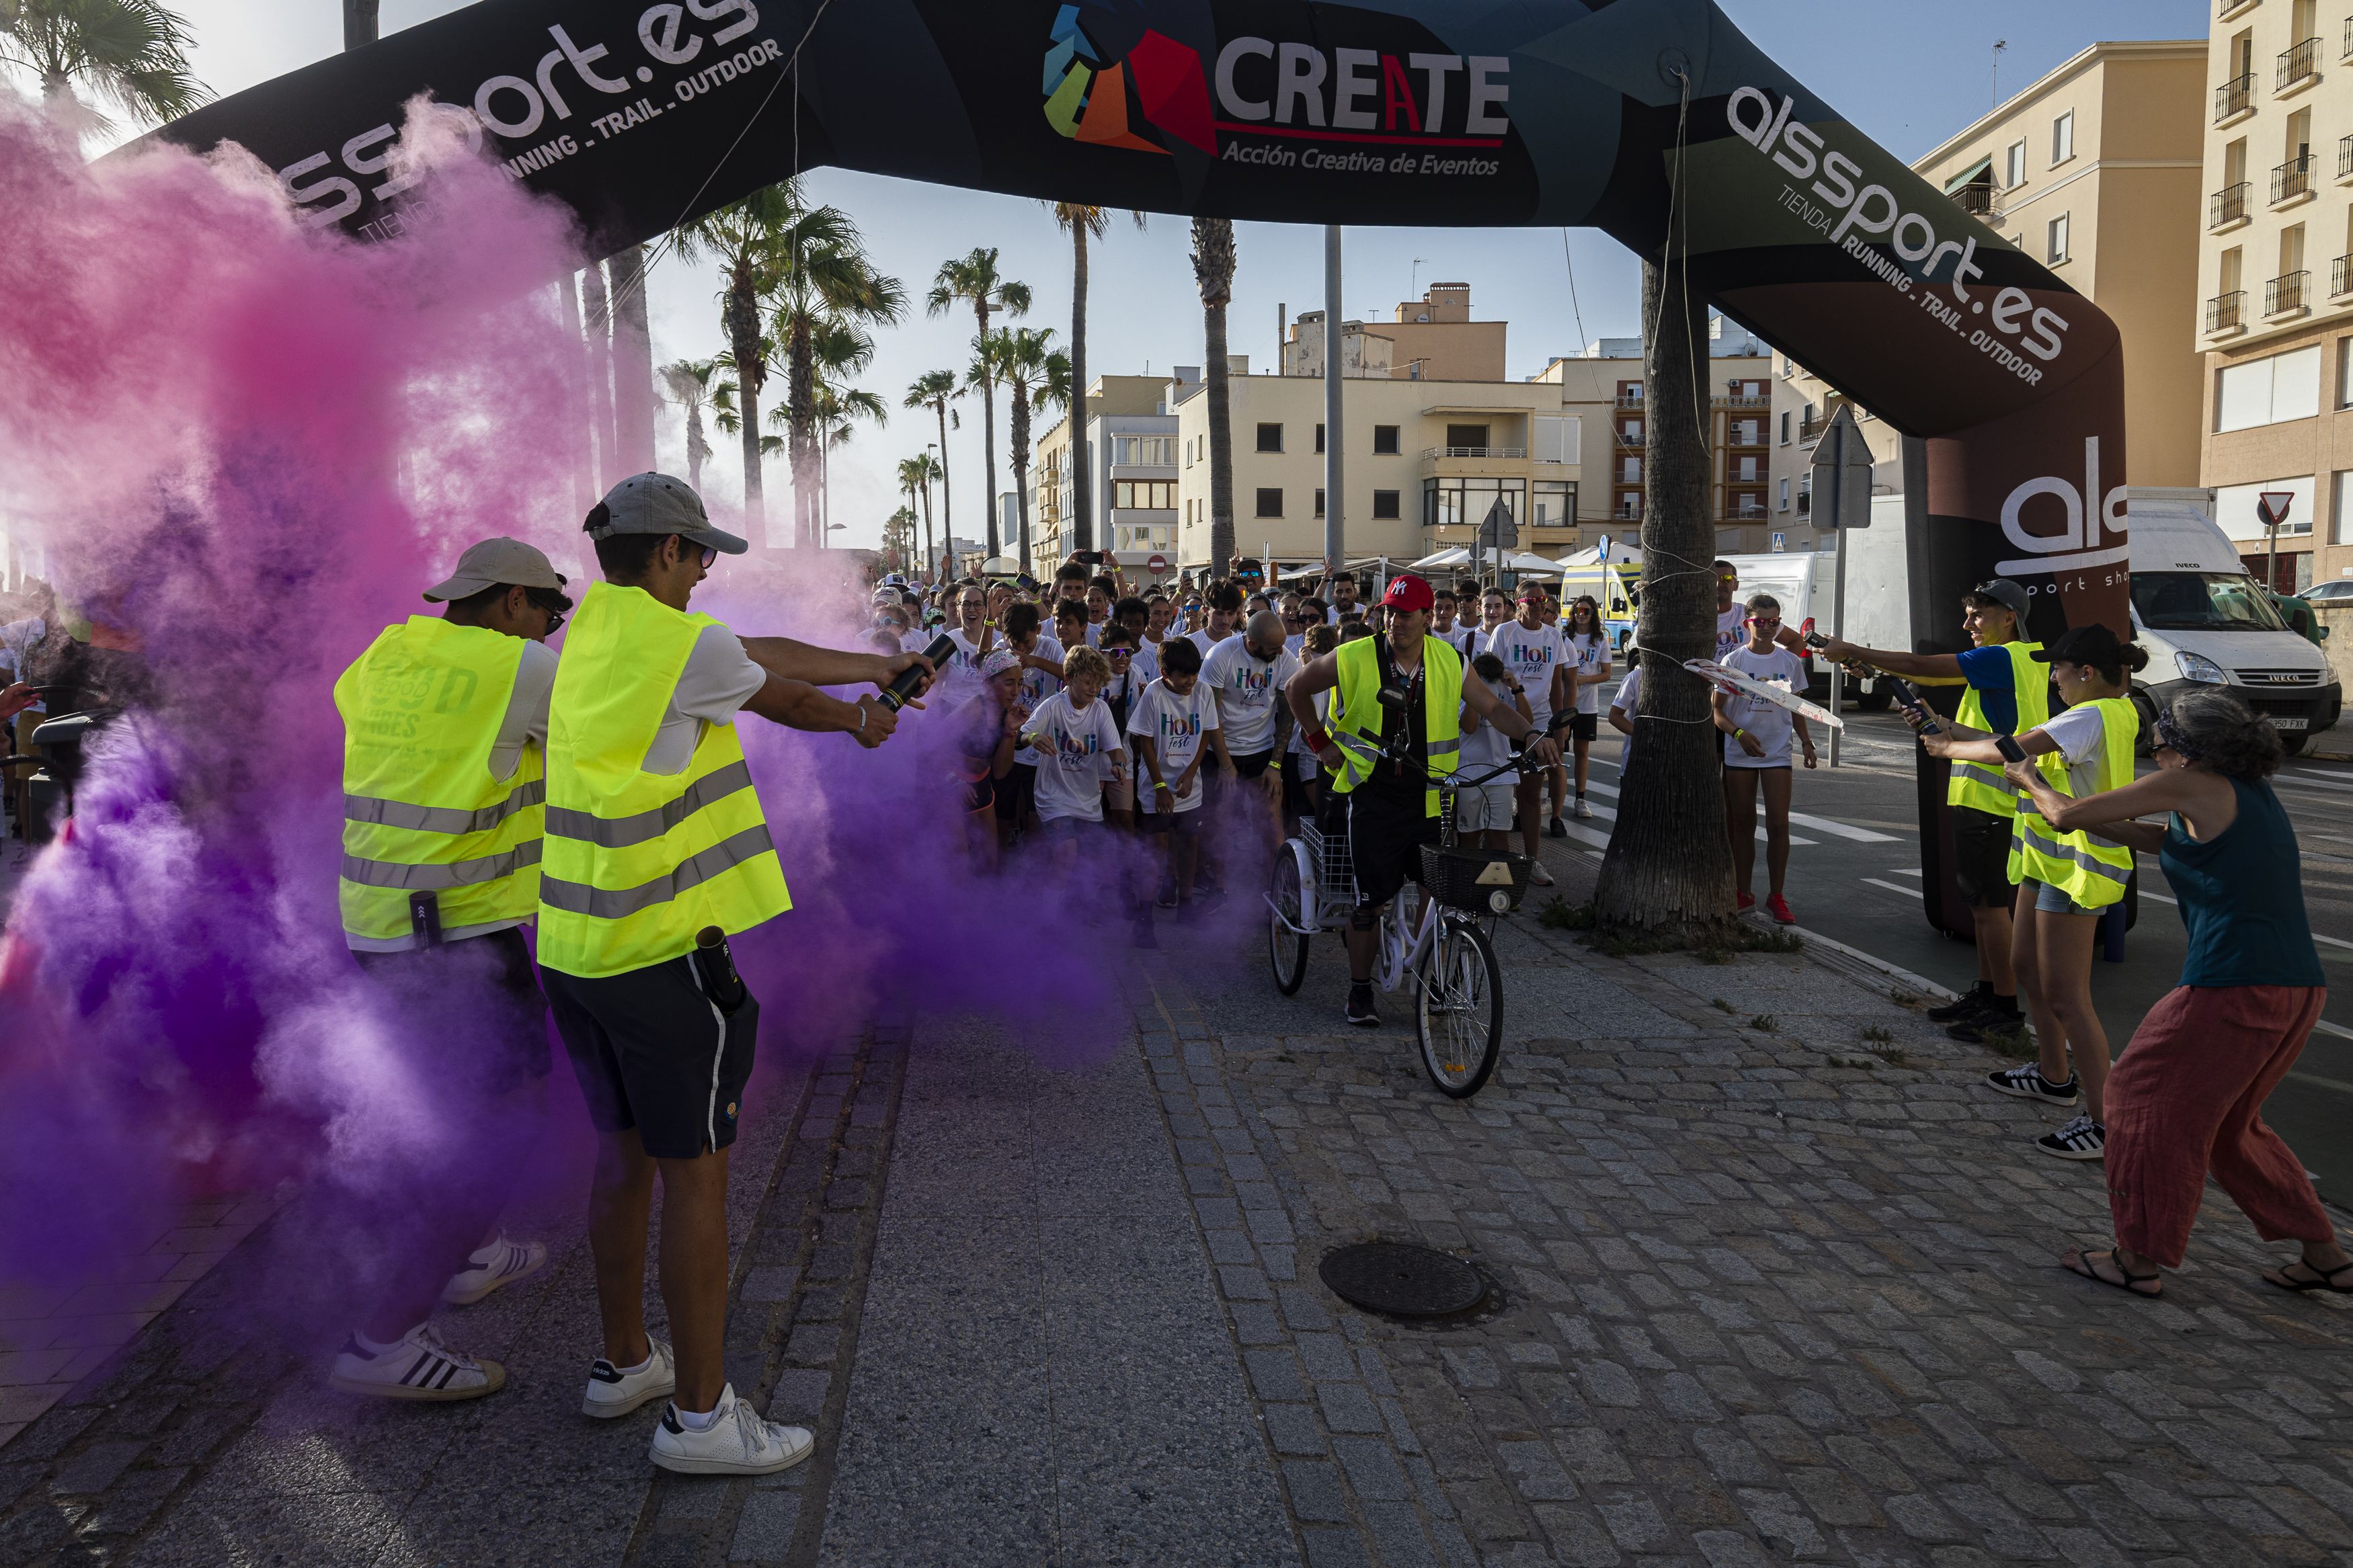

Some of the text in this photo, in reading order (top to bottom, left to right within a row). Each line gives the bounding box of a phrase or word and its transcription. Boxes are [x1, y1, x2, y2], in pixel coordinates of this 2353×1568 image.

[590, 97, 663, 139] TRAIL
[674, 38, 784, 101] OUTDOOR
[1215, 36, 1510, 134] CREATE
[1222, 140, 1499, 175] Acción Creativa de Eventos
[1726, 86, 2069, 360] alssport.es
[1778, 183, 2043, 387] TIENDA RUNNING TRAIL OUTDOOR
[2026, 571, 2130, 596] port sho
[1717, 626, 1744, 645] oli
[1514, 645, 1552, 663] Holi
[1522, 661, 1544, 673] Fest
[2269, 674, 2300, 682] IVECO
[1162, 712, 1201, 736] Holi
[2290, 720, 2305, 729] FXK
[1168, 735, 1191, 750] Fest
[1059, 753, 1085, 765] Fest
